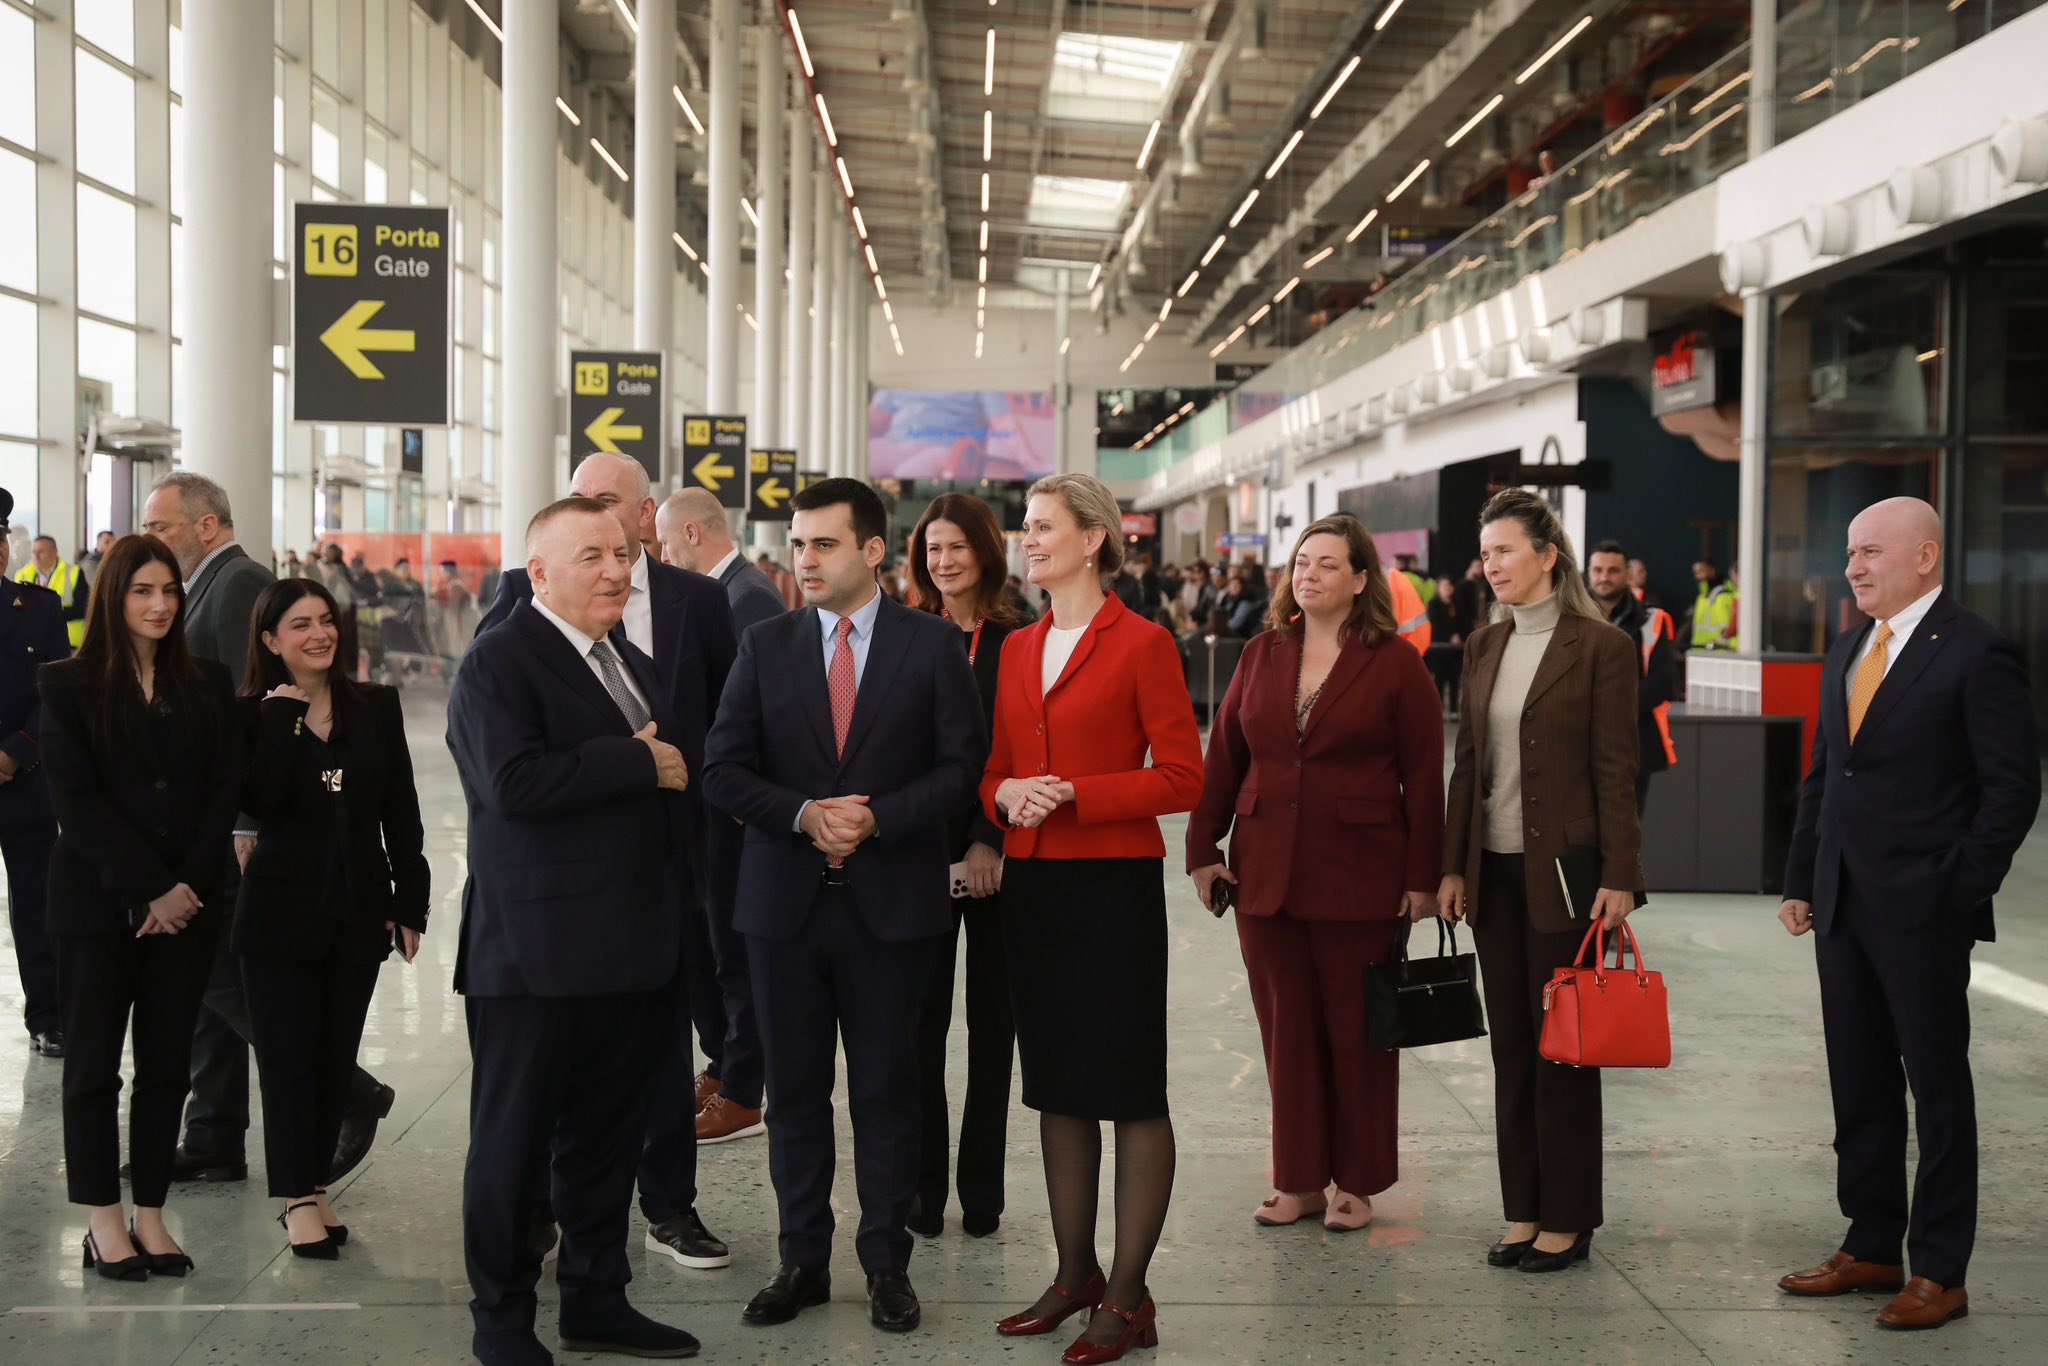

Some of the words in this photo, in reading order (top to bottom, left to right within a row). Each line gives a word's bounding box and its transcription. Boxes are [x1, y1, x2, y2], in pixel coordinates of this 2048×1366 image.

[375, 225, 440, 248] Porta
[311, 234, 355, 265] 16
[374, 254, 430, 278] Gate
[579, 369, 604, 388] 15
[617, 362, 658, 378] Porta
[616, 380, 651, 396] Gate
